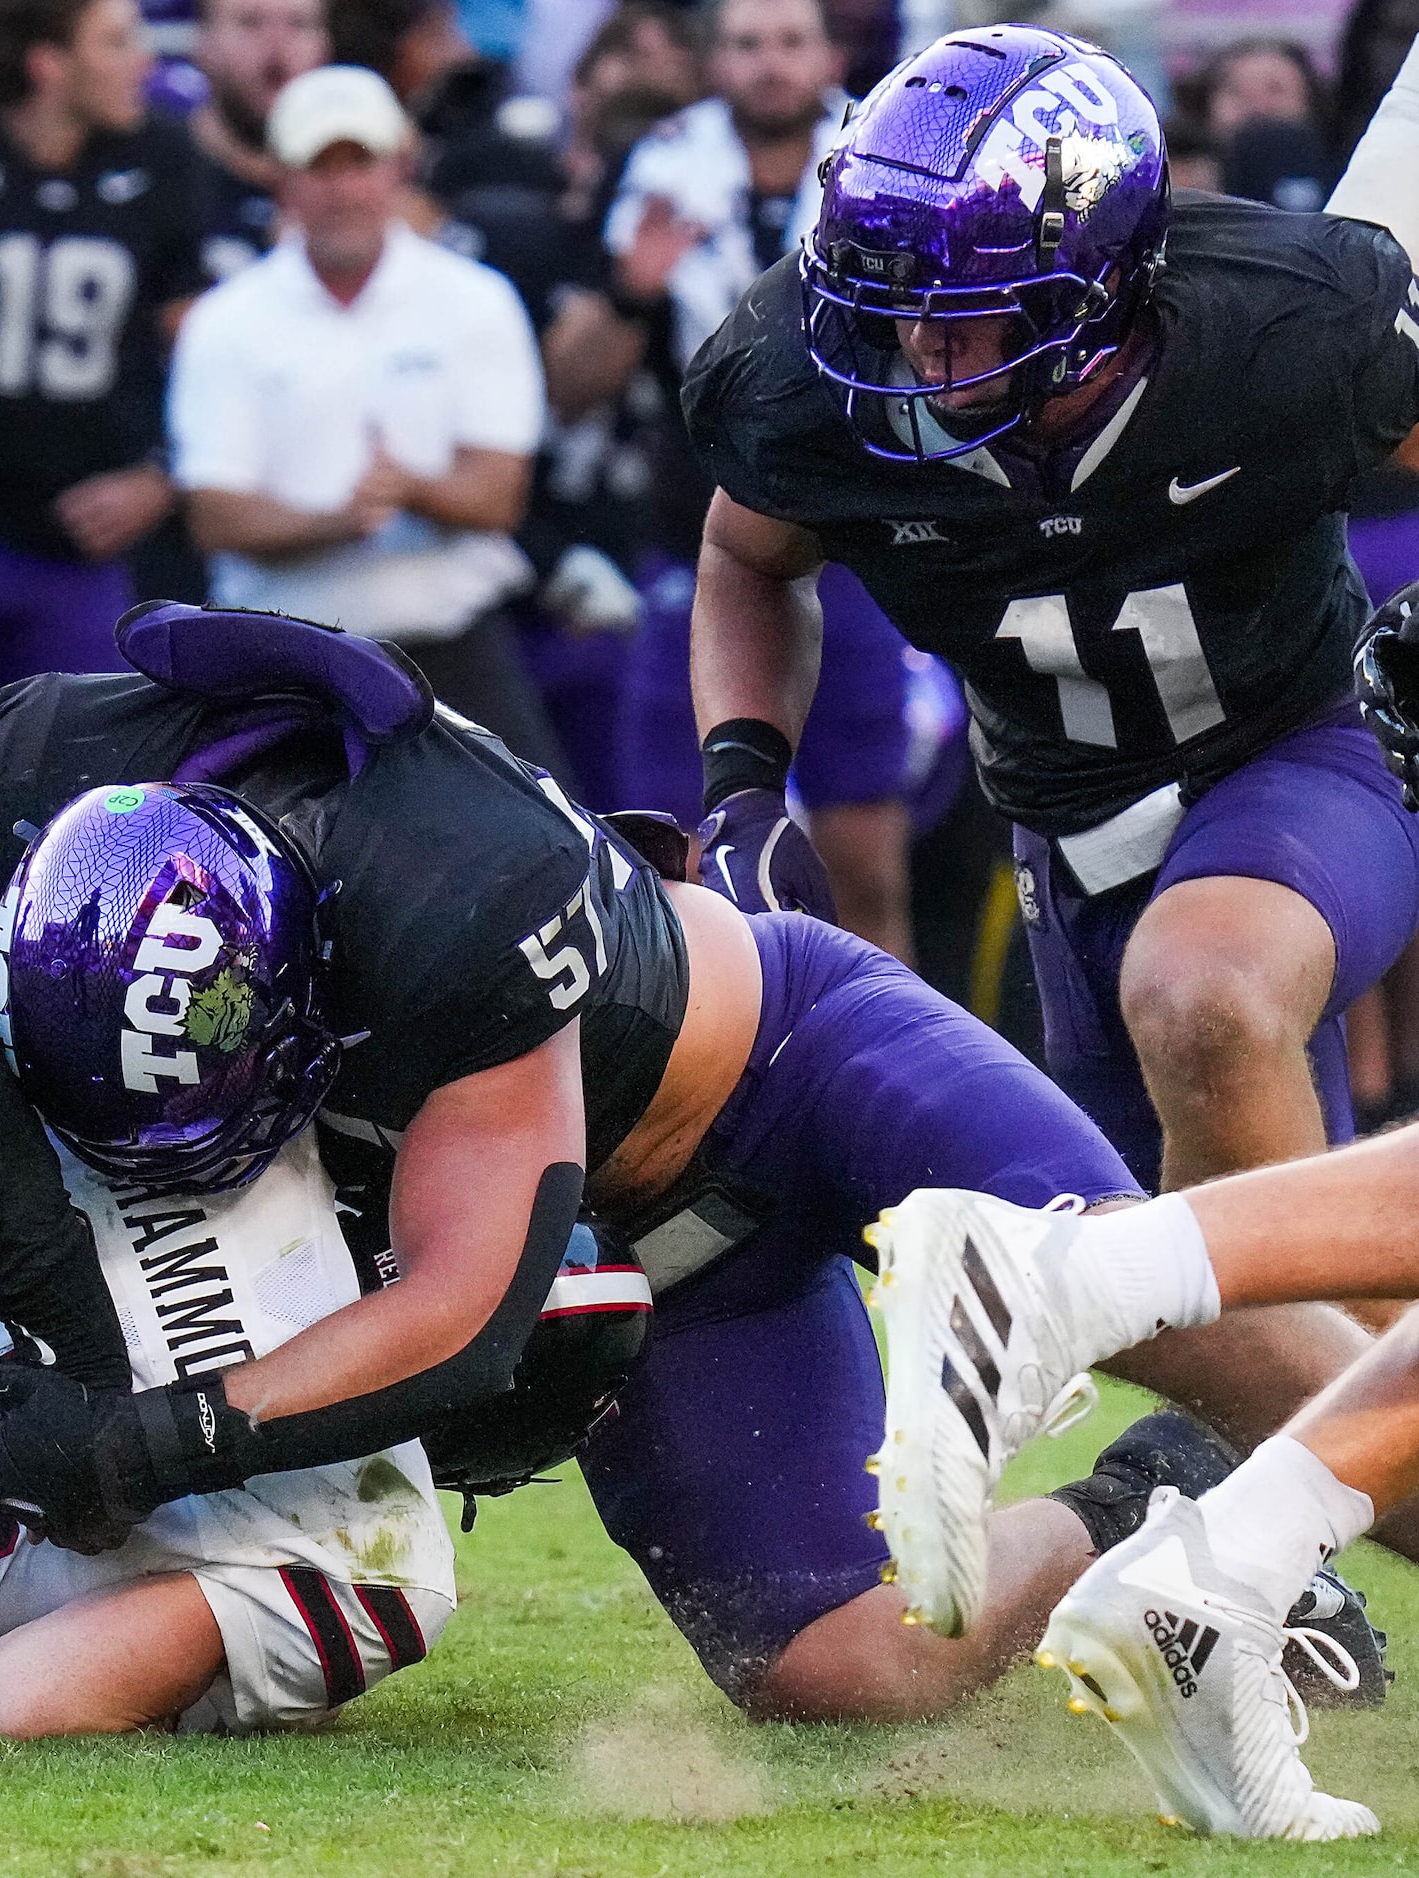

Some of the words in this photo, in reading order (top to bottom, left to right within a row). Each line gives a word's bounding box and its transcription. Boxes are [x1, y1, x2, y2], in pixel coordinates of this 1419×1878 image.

[974, 62, 1119, 213] TCU
[1038, 516, 1082, 539] TCU
[994, 582, 1227, 746] 11
[120, 901, 225, 1095] TCU
[517, 873, 609, 1011] 57
[1143, 1609, 1198, 1698] adidas
